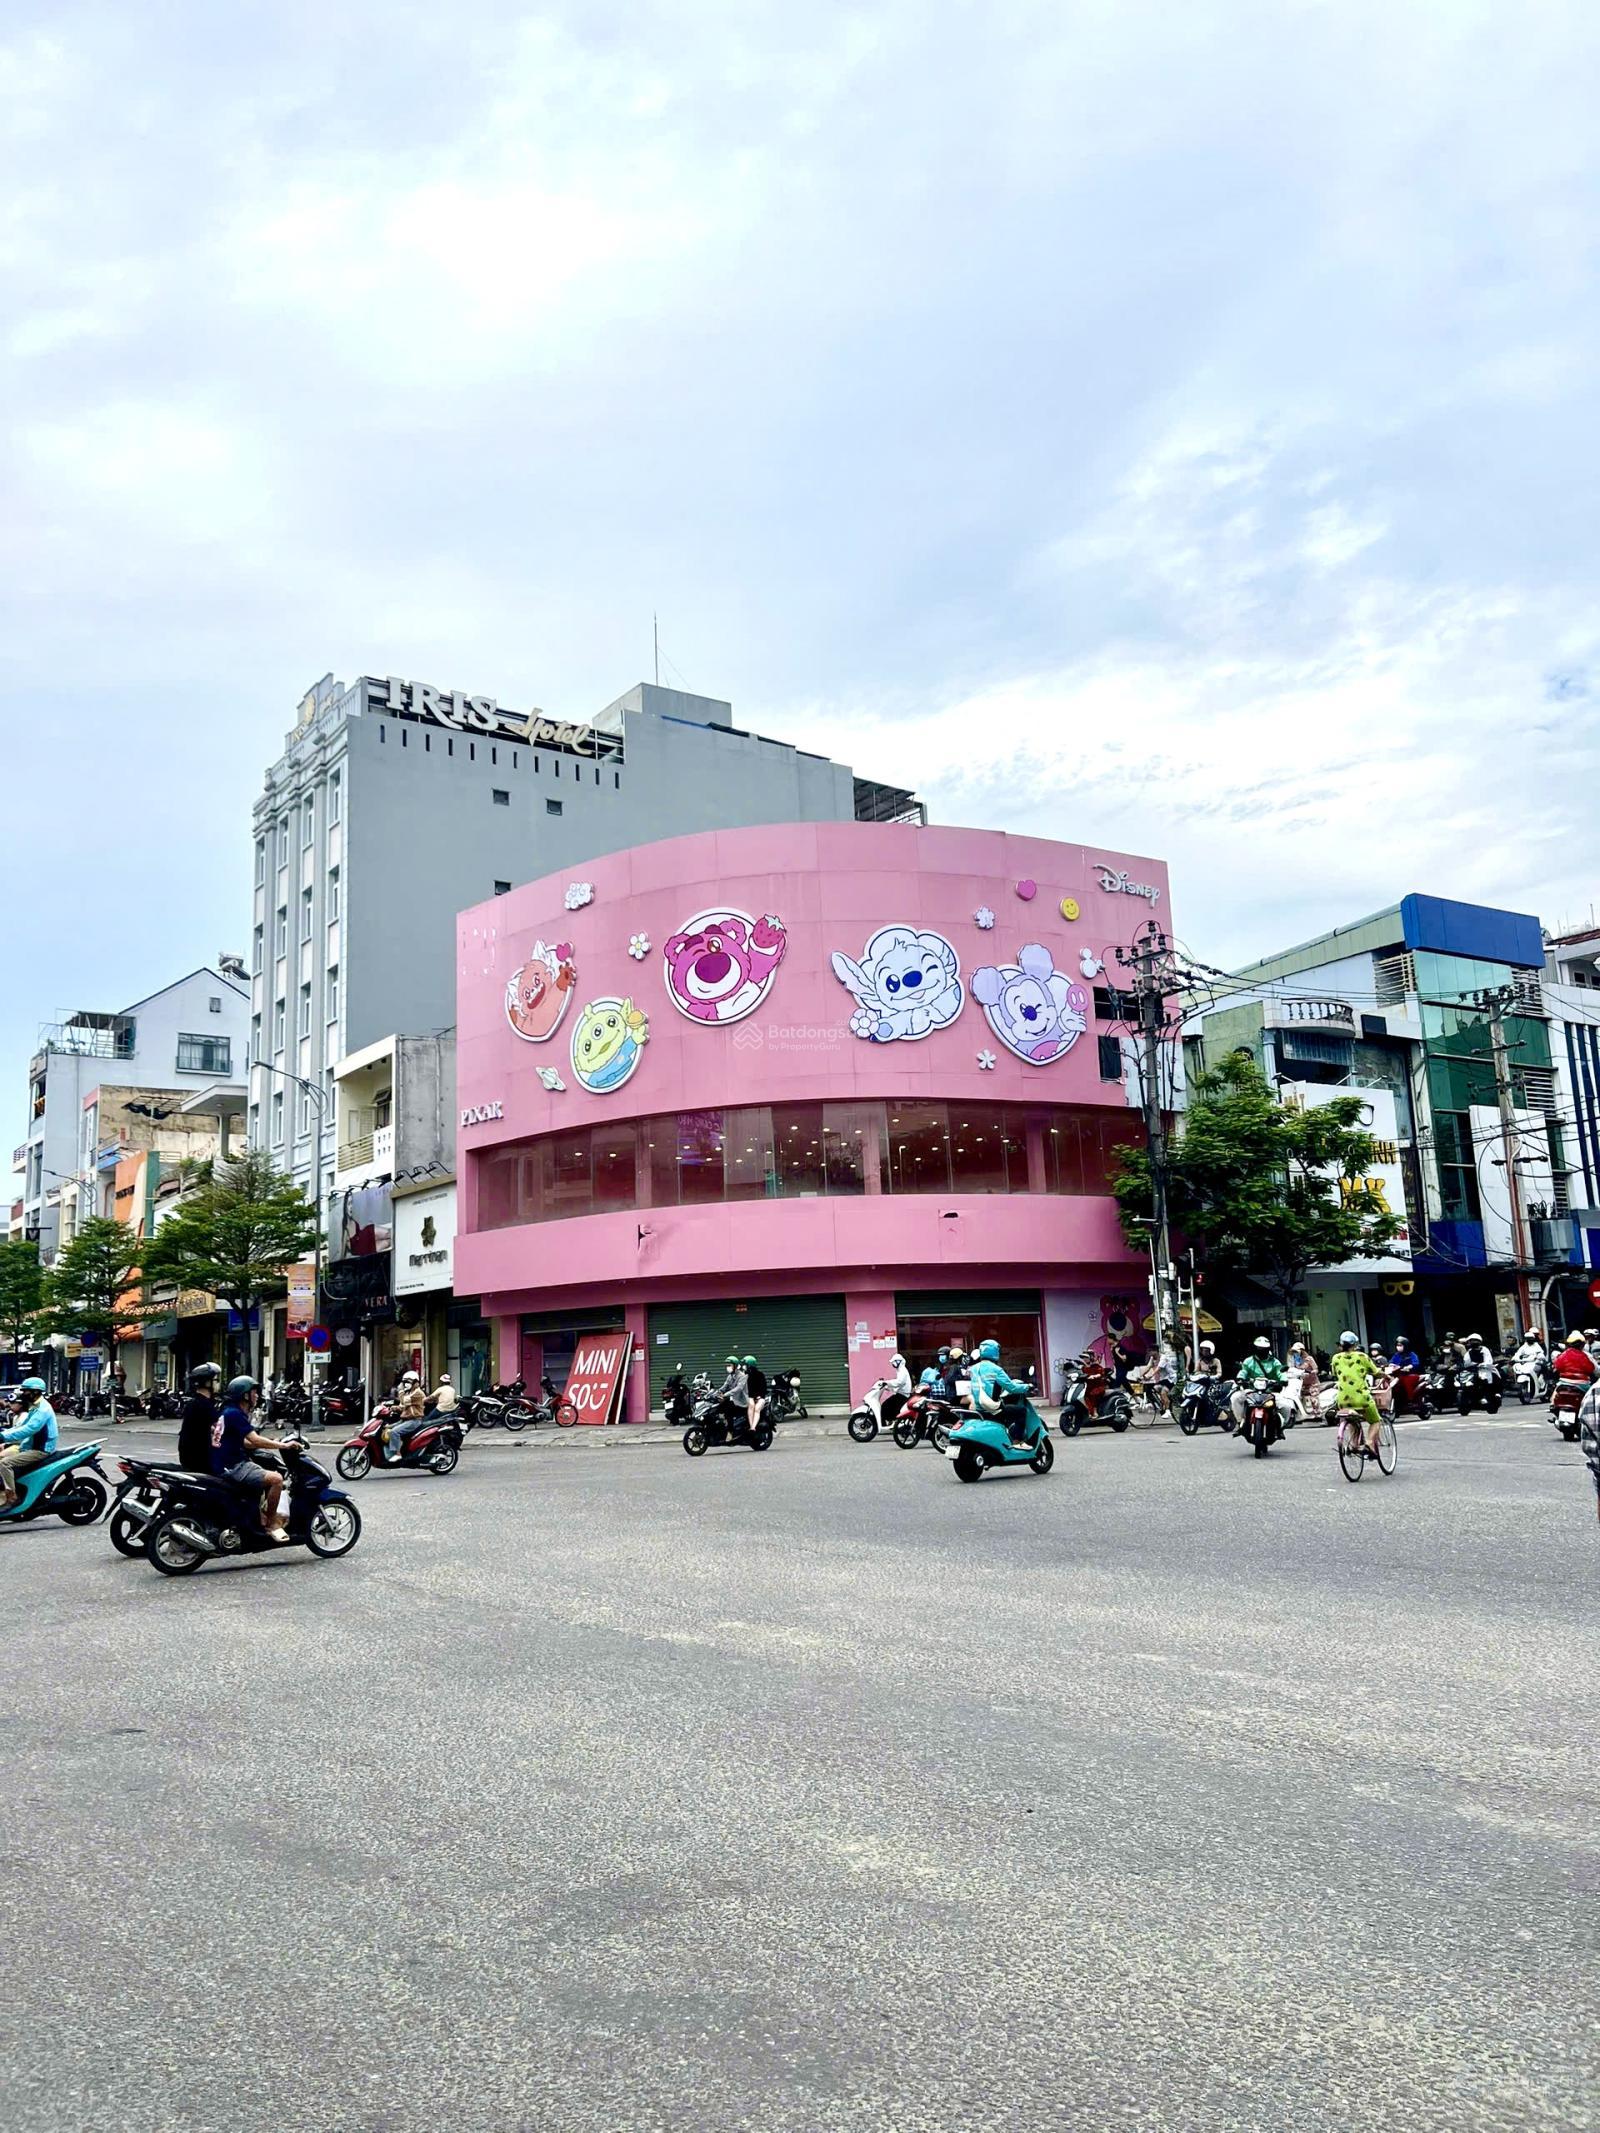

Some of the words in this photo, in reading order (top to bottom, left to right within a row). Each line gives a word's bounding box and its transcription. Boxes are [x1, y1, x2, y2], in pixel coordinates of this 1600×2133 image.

[386, 676, 497, 731] IRIS
[1092, 863, 1160, 909] Disney
[460, 1101, 503, 1127] PIXAR
[573, 1349, 617, 1375] MINI
